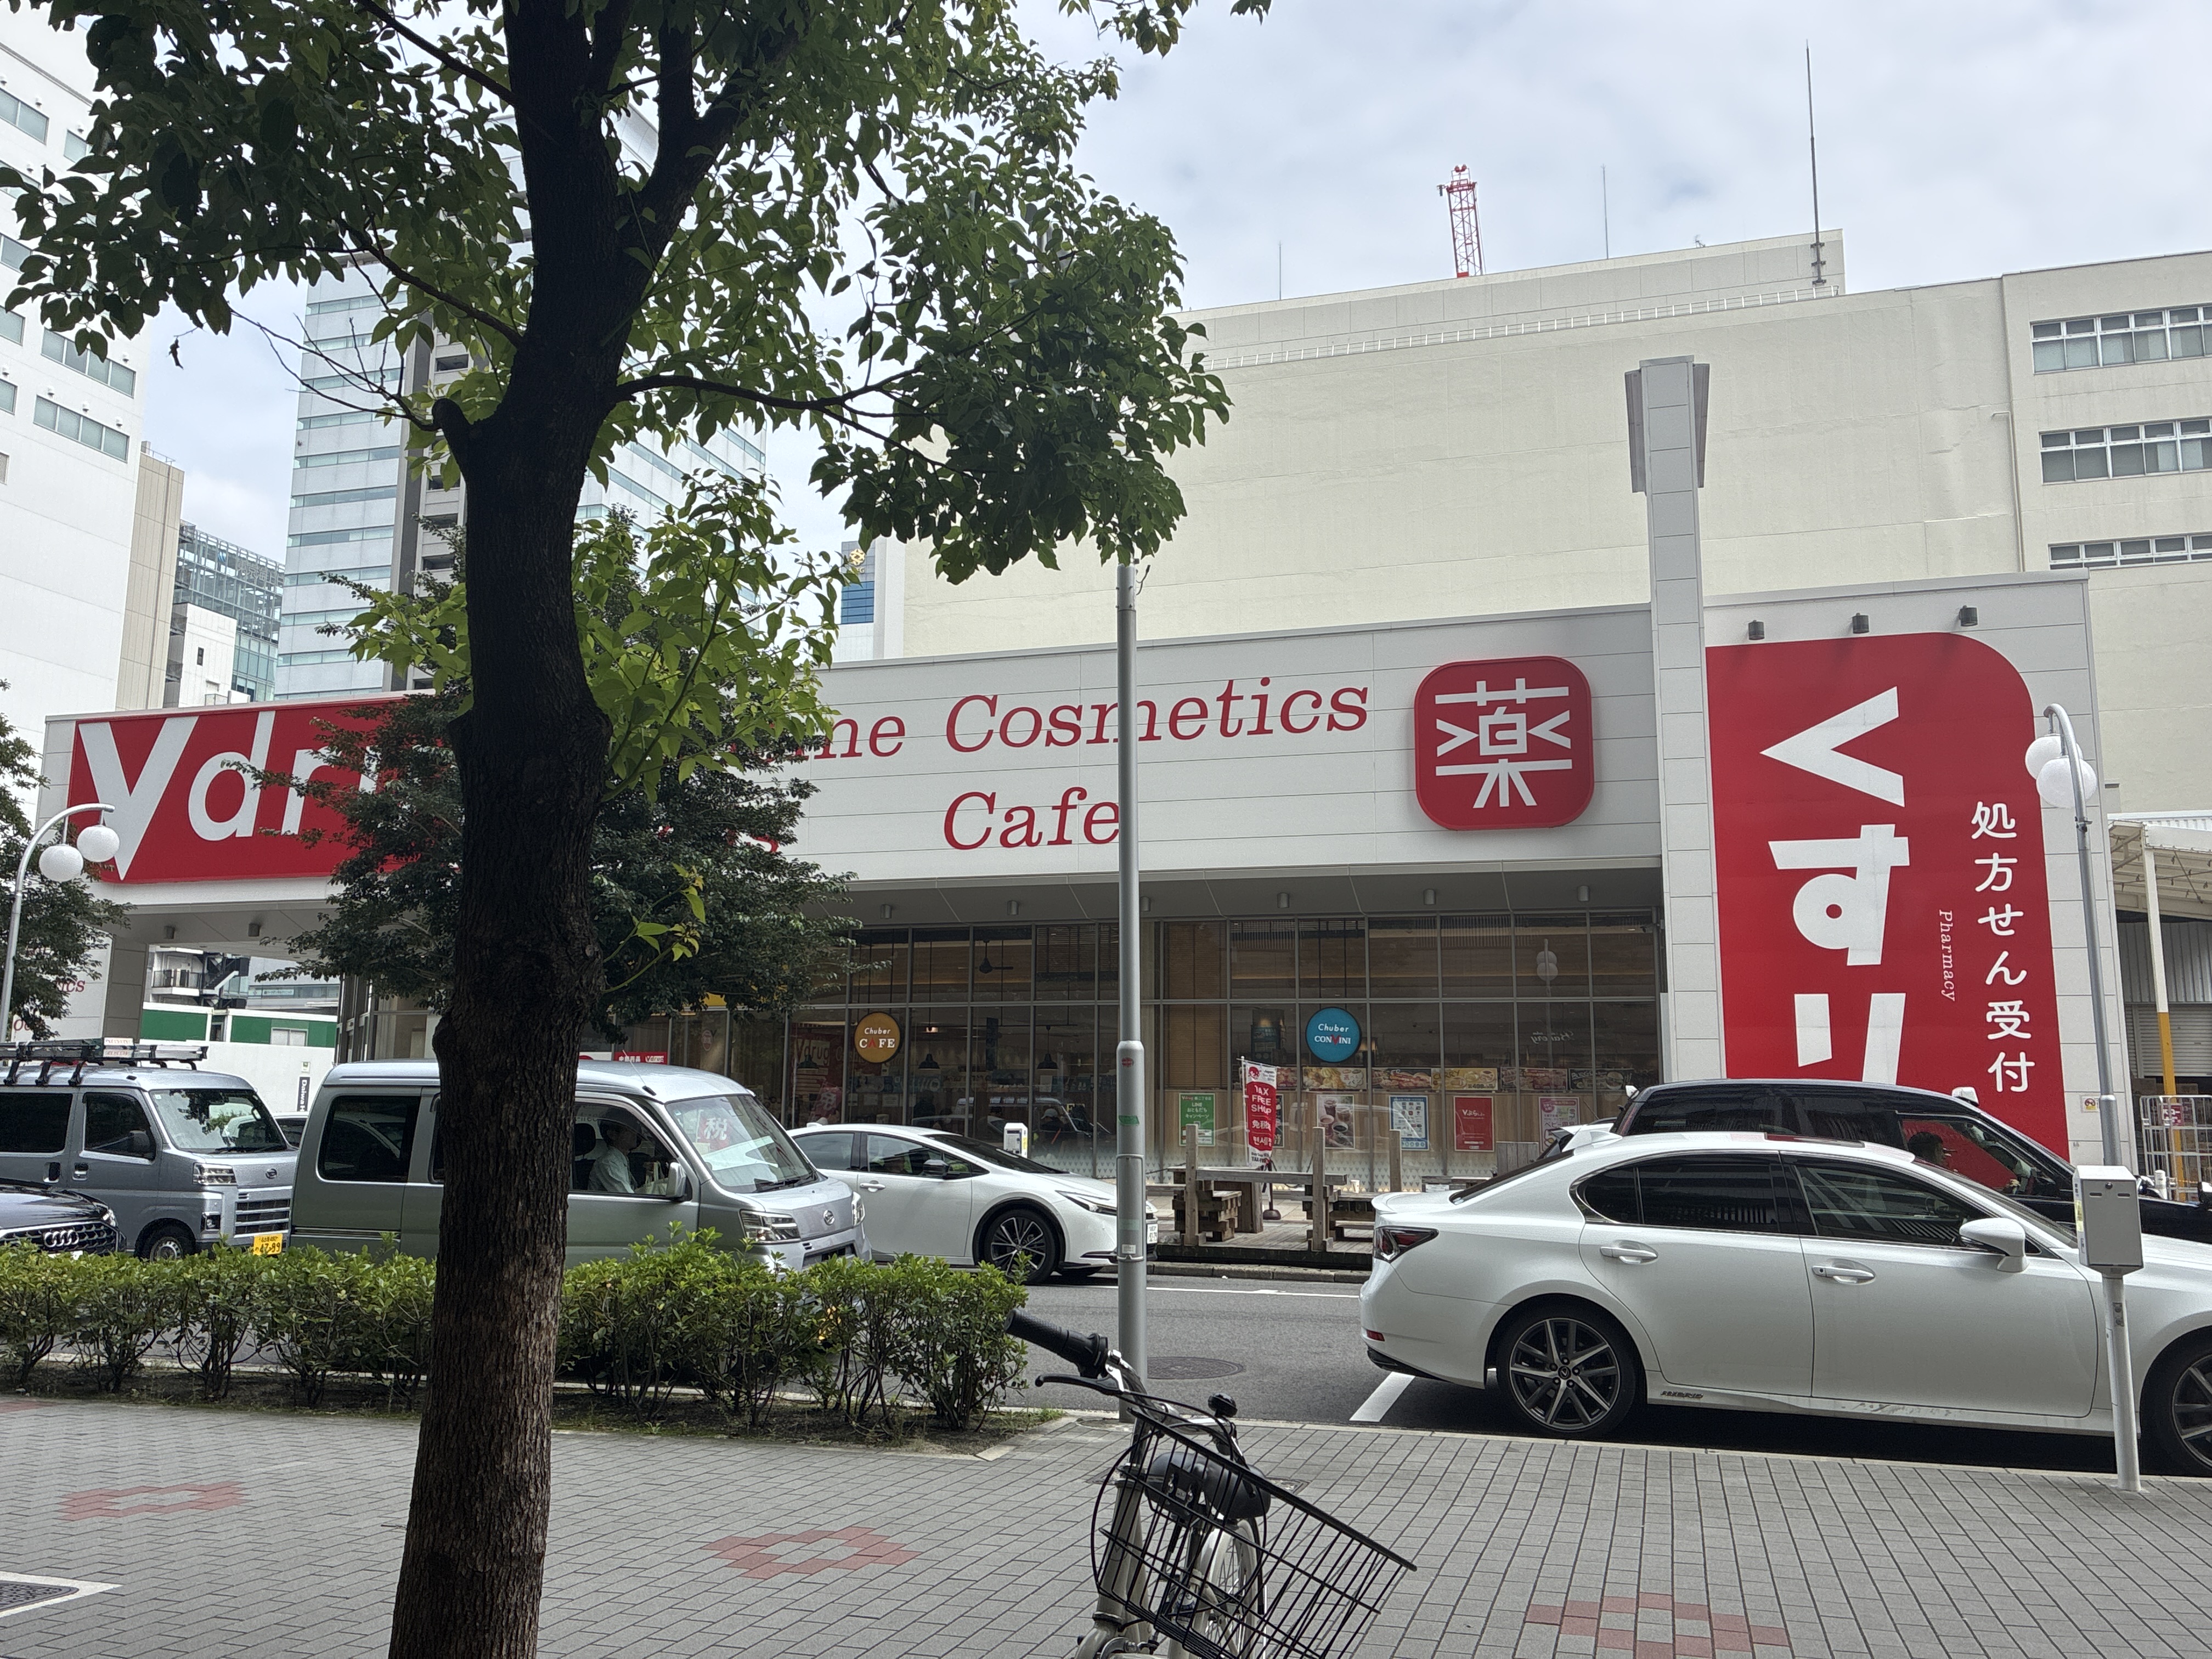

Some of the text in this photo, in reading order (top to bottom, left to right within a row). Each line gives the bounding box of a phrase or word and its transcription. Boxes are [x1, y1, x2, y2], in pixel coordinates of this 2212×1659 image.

[946, 676, 1368, 753] Cosmetics
[1435, 678, 1572, 809] 薬
[943, 786, 1120, 850] Cafe
[1759, 686, 1910, 1084] くすり
[1971, 802, 2036, 1093] 処方せん受付
[1937, 909, 1957, 1002] Pharmacy
[864, 1027, 891, 1035] Chuber
[1318, 1023, 1349, 1032] Chuber
[859, 1037, 895, 1049] CAFE
[1314, 1034, 1351, 1045] CONVINI
[1254, 1085, 1269, 1096] TAX
[1252, 1094, 1272, 1106] FREE
[1251, 1104, 1272, 1115] SHOP
